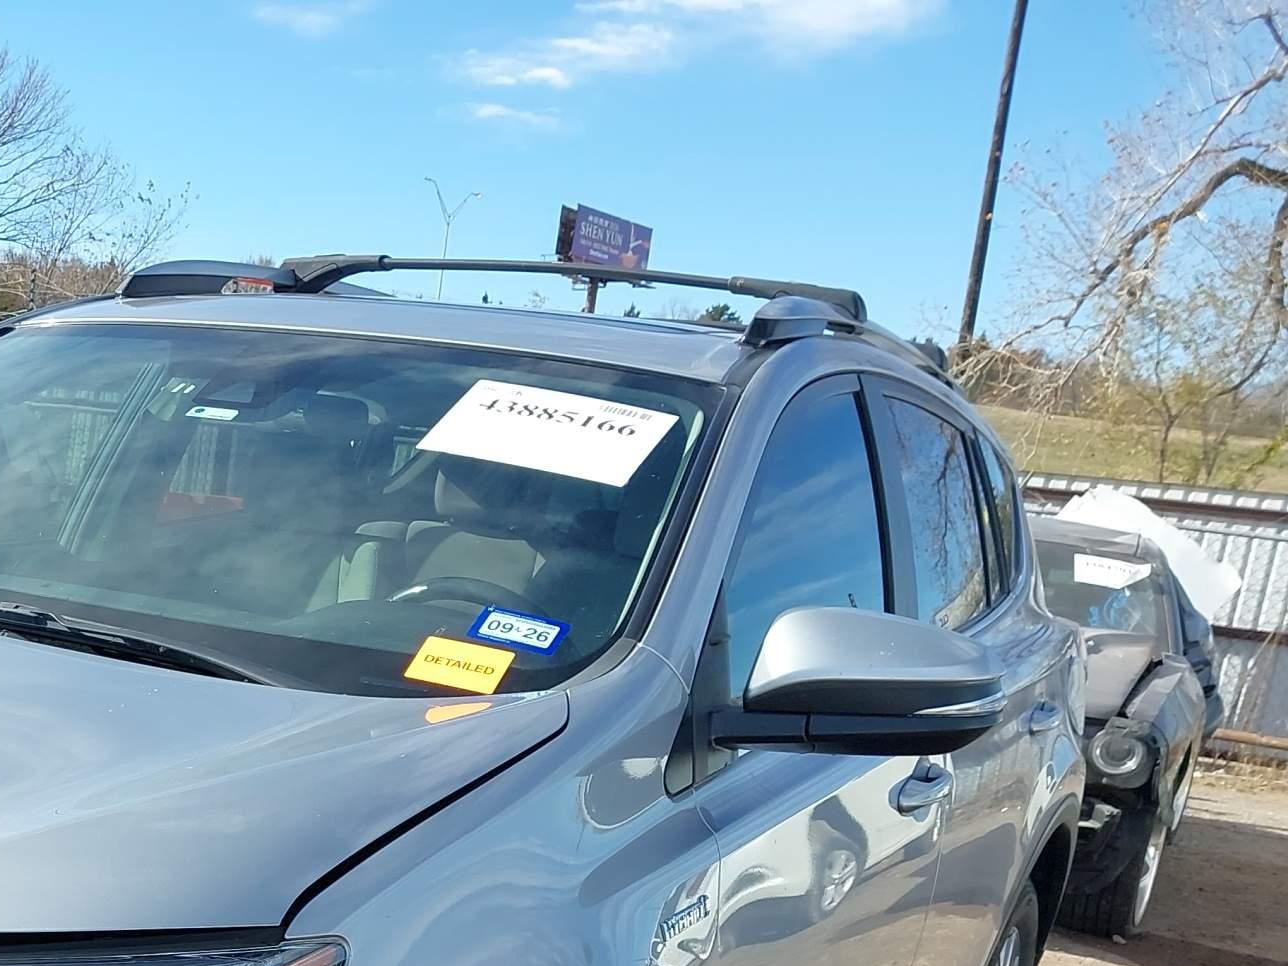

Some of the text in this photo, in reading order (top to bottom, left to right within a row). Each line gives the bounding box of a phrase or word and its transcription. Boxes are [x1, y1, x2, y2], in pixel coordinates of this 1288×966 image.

[580, 222, 604, 241] SHEN
[606, 230, 623, 246] YUN
[479, 398, 637, 437] 43885166
[487, 619, 514, 634] 09
[522, 627, 551, 643] 26
[423, 654, 495, 676] DETAILED
